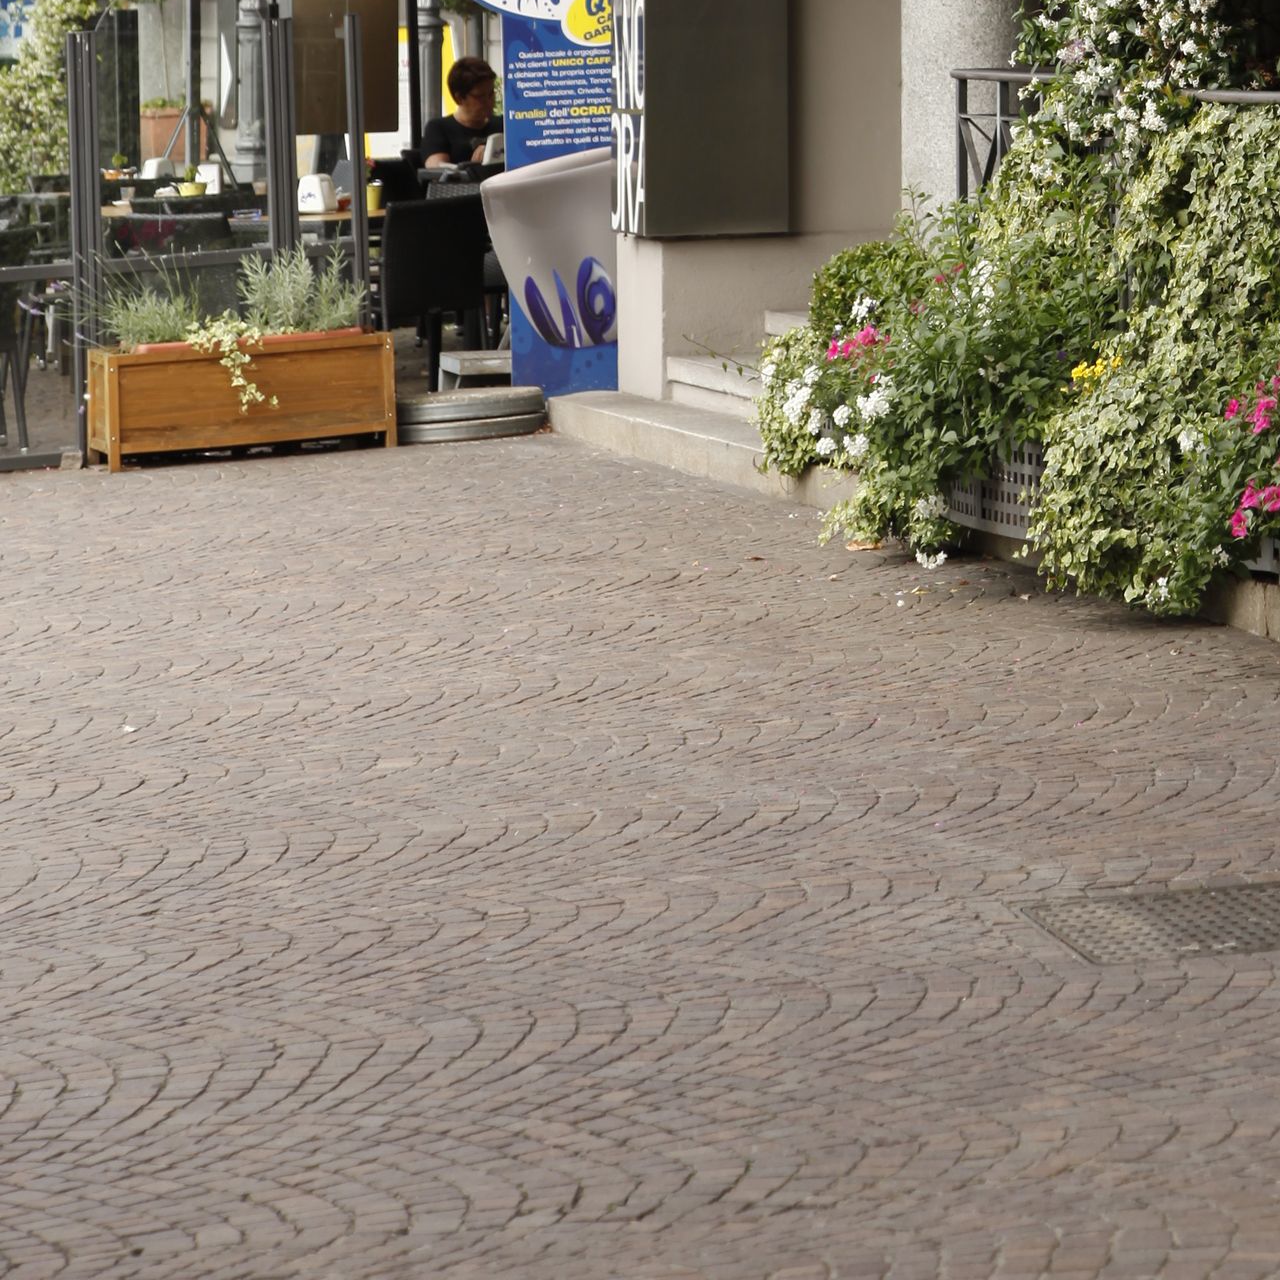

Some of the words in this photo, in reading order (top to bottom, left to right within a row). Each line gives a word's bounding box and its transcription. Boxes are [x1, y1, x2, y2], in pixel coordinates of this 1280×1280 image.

[518, 51, 544, 59] Questo
[573, 48, 610, 57] orgoglioso
[515, 61, 526, 69] Voi
[527, 60, 547, 68] clienti
[514, 71, 548, 79] dichiarare
[559, 69, 585, 77] propria
[573, 98, 585, 106] per
[534, 118, 555, 126] muffa
[556, 116, 591, 124] altamente
[542, 128, 574, 137] presente
[575, 126, 597, 134] anche
[525, 138, 564, 147] soprattutto
[573, 136, 591, 144] quelli
